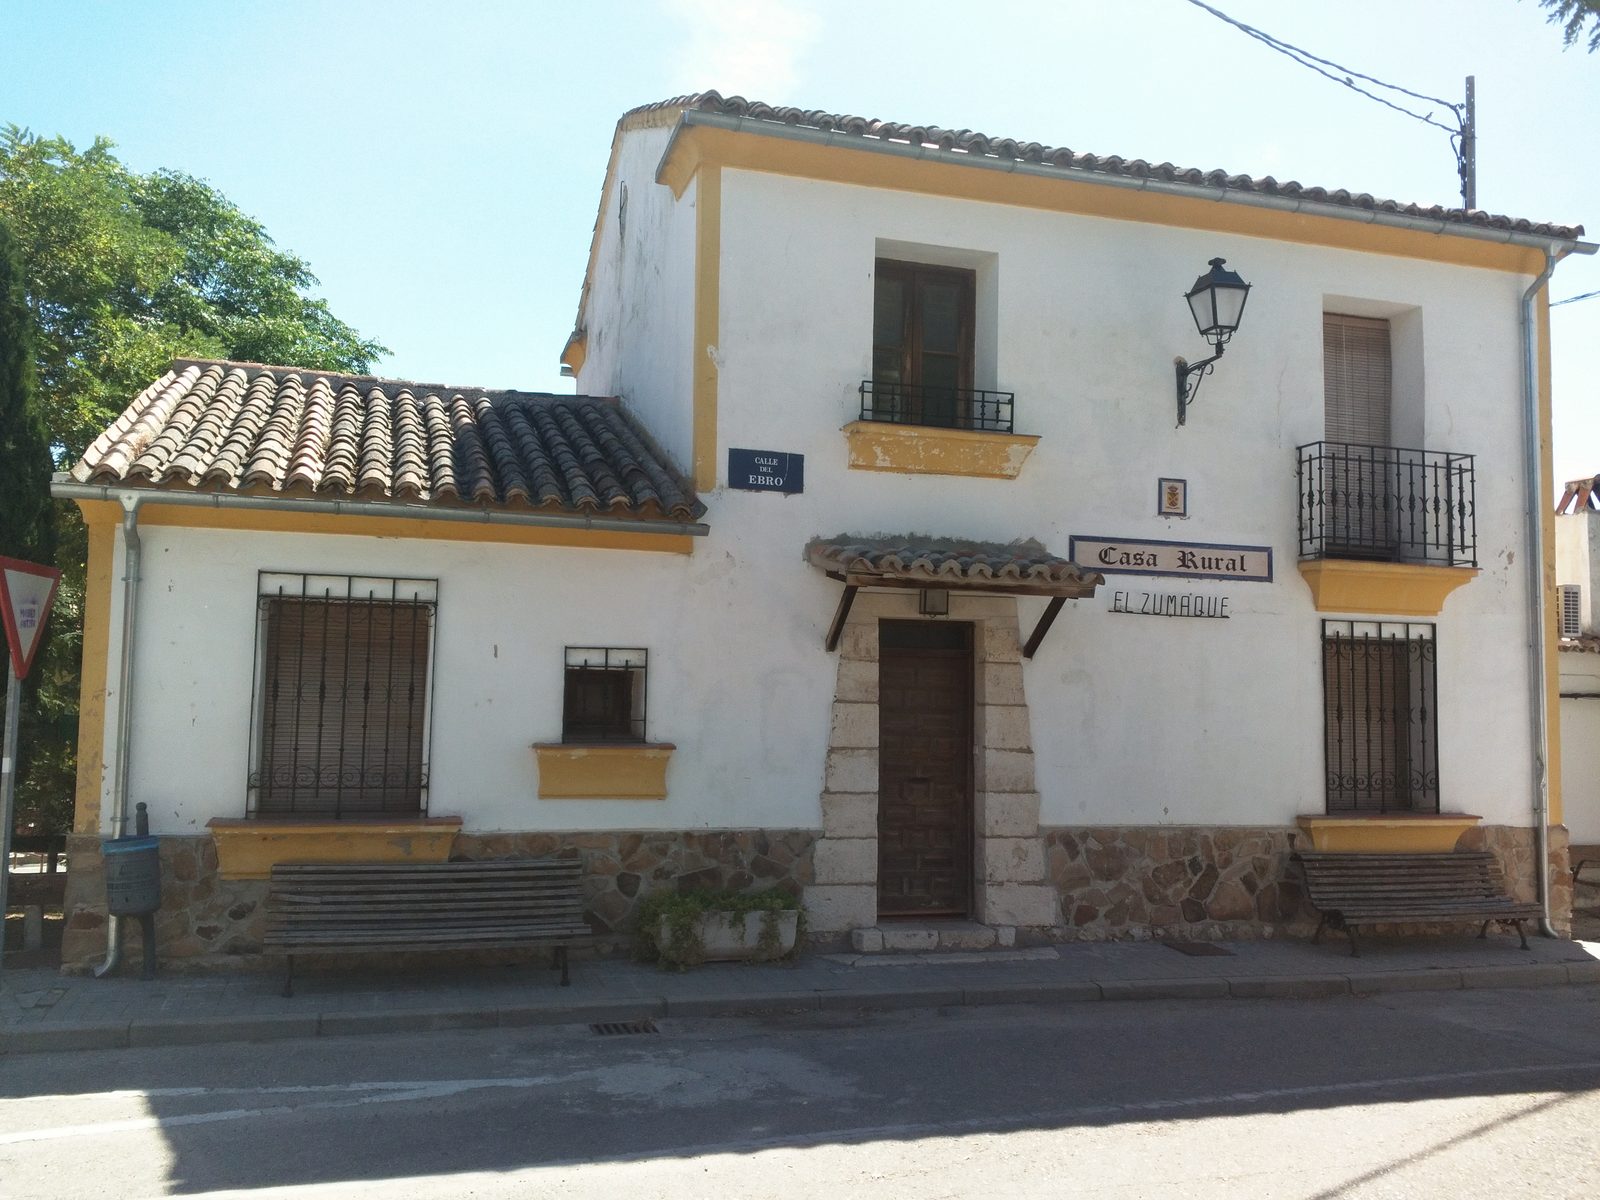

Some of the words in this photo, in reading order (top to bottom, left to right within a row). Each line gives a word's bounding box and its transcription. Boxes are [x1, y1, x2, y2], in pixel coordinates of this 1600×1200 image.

[754, 456, 778, 466] CALLE
[748, 474, 783, 486] EBRO
[1098, 546, 1158, 567] Casa
[1176, 550, 1248, 572] Rural
[1113, 591, 1133, 612] EL
